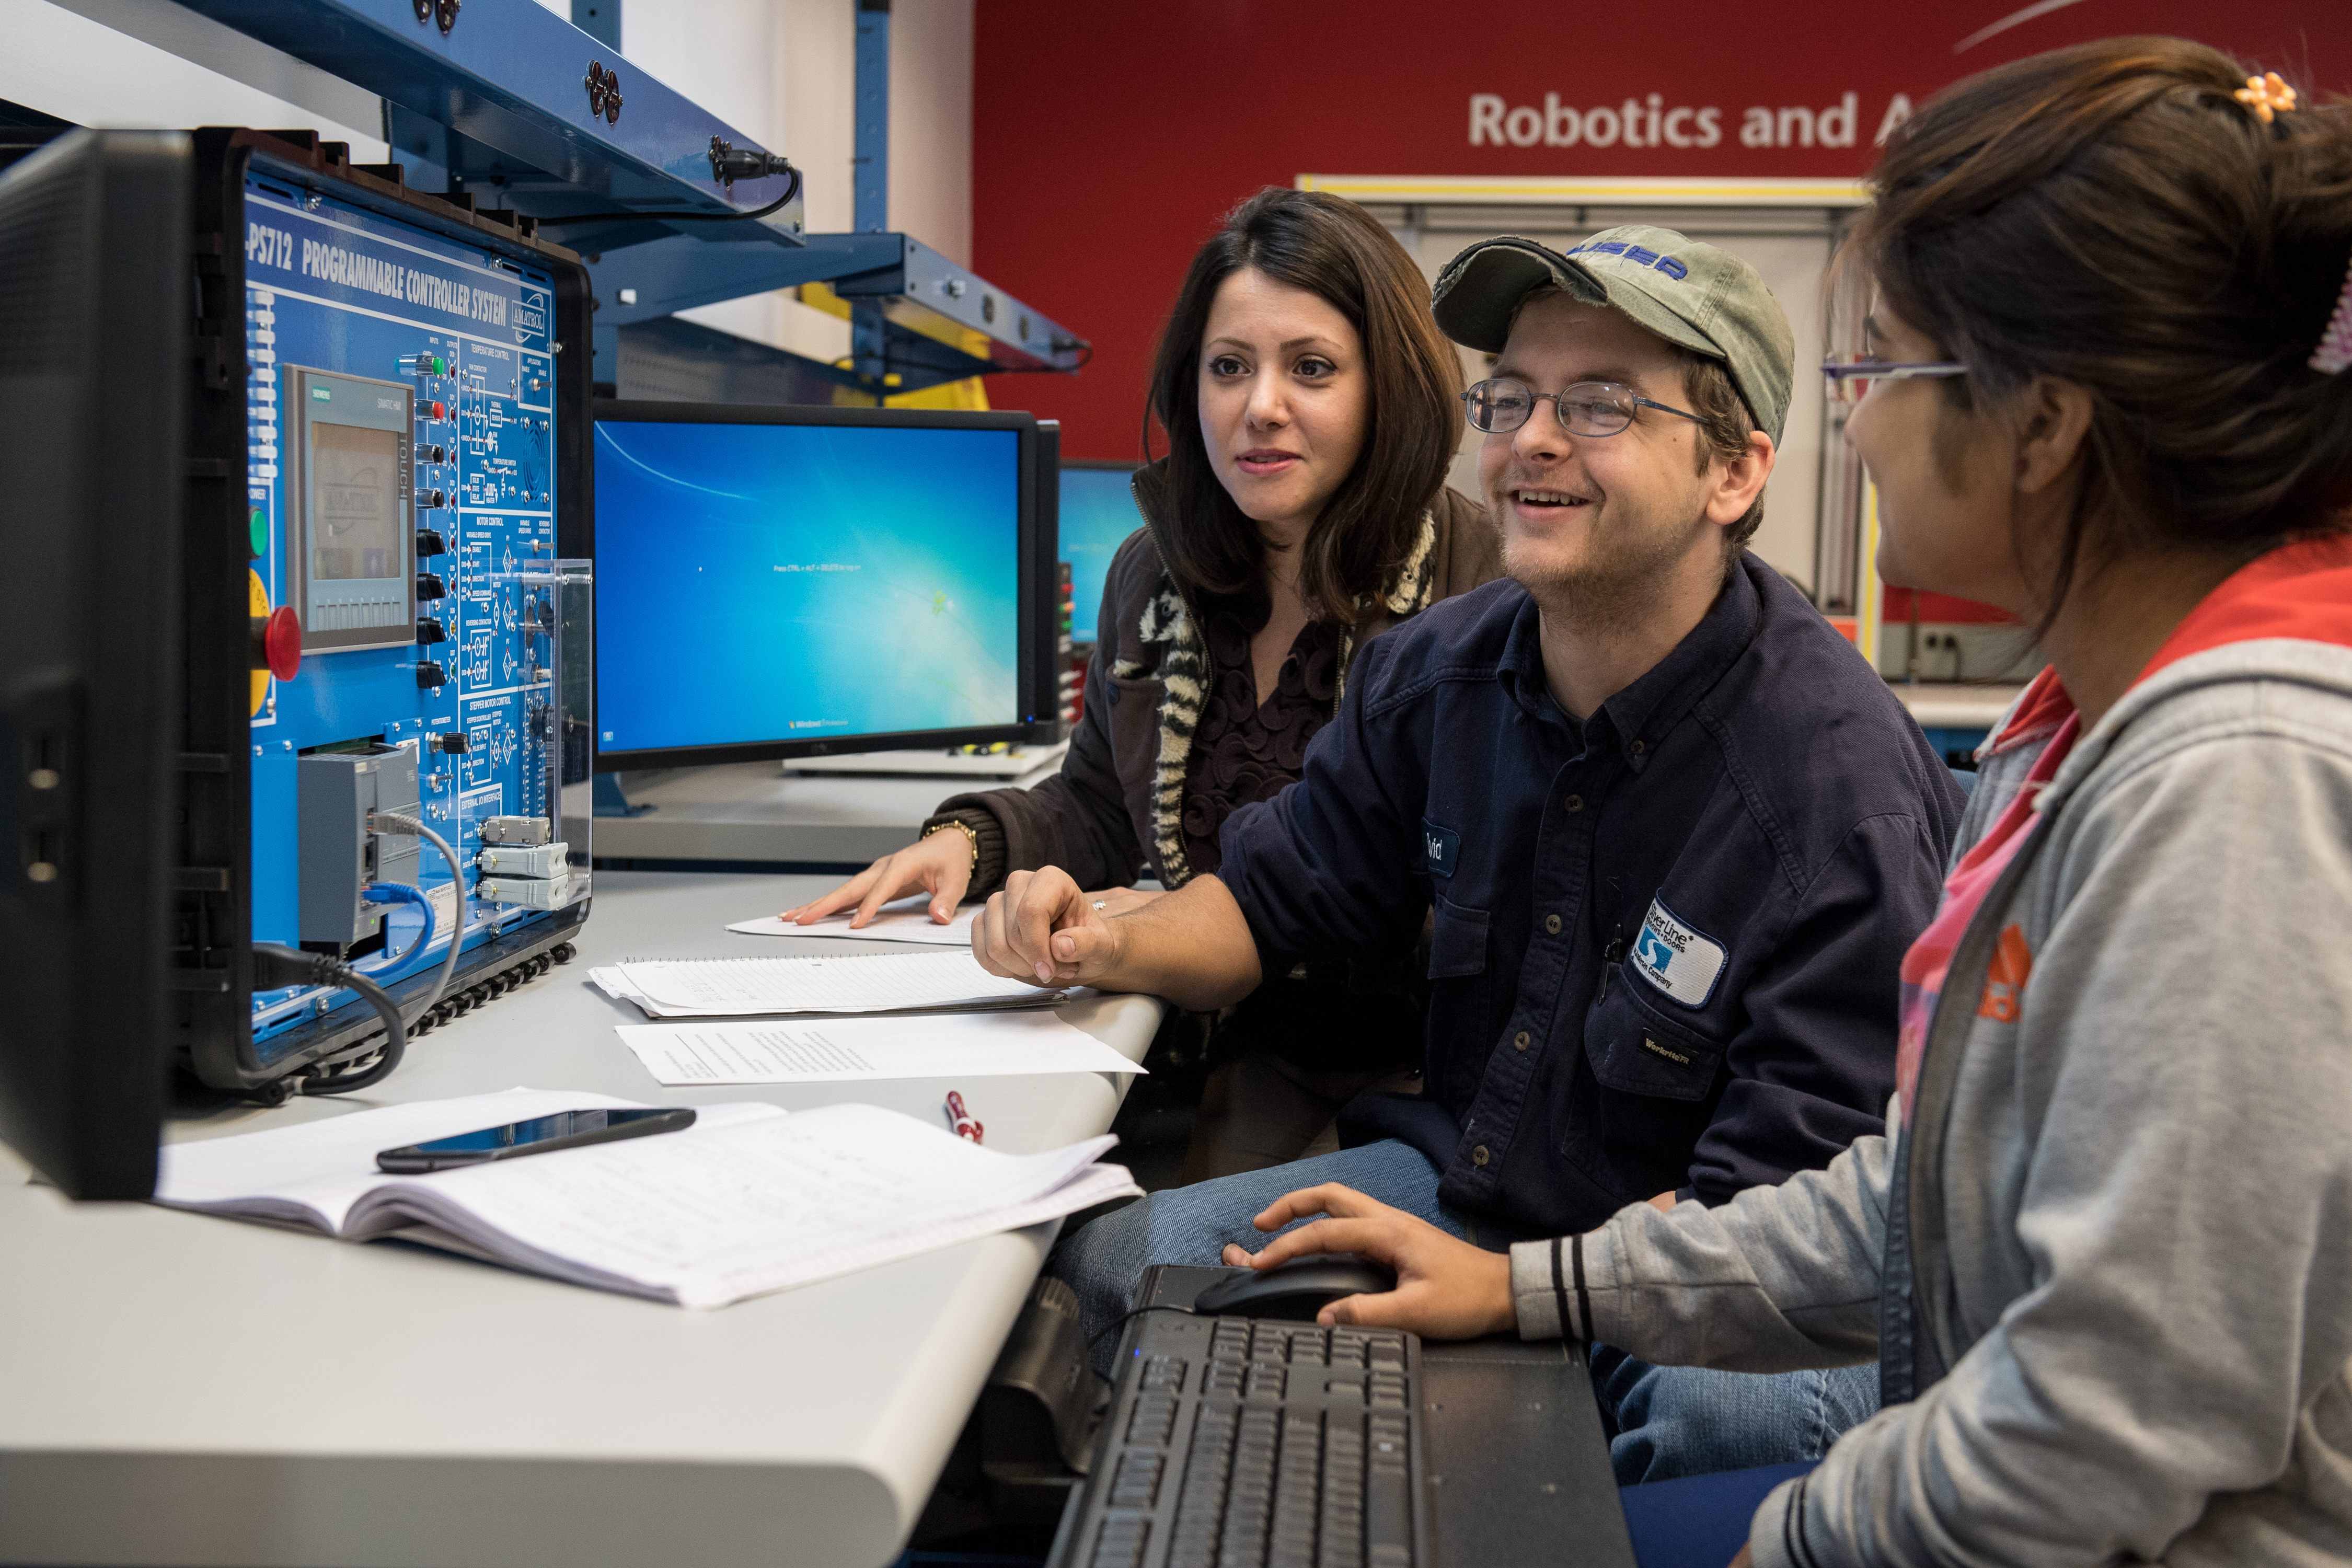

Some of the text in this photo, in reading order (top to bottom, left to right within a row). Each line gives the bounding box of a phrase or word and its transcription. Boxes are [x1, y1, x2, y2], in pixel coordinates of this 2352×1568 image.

[1468, 92, 1723, 148] Robotics
[1739, 90, 1859, 148] and
[302, 238, 403, 300] PROGRAMMABLE
[407, 269, 469, 317] CONTROLLER
[472, 288, 506, 327] SYSTEM
[514, 308, 543, 330] AMATROL
[446, 340, 458, 349] OUTPUTS
[471, 343, 510, 361] TEMPERATURE CONTROL
[474, 364, 487, 373] CONTACTOR
[527, 358, 541, 366] APPLICATIONS
[477, 517, 503, 526] MOTOR CONTROL
[469, 696, 511, 711] STEPPER MOTOR CONTROL
[431, 716, 451, 725] POTENTIOMETER
[467, 713, 491, 724] STEPPER CONTROLLER
[462, 798, 478, 810] EXTERNAL
[483, 791, 500, 805] INTERFACE
[464, 831, 474, 839] ANALOG
[1650, 903, 1687, 946] Silver Line
[1663, 935, 1686, 953] DOORS
[1647, 966, 1673, 989] Company
[1646, 1037, 1680, 1061] Workrite
